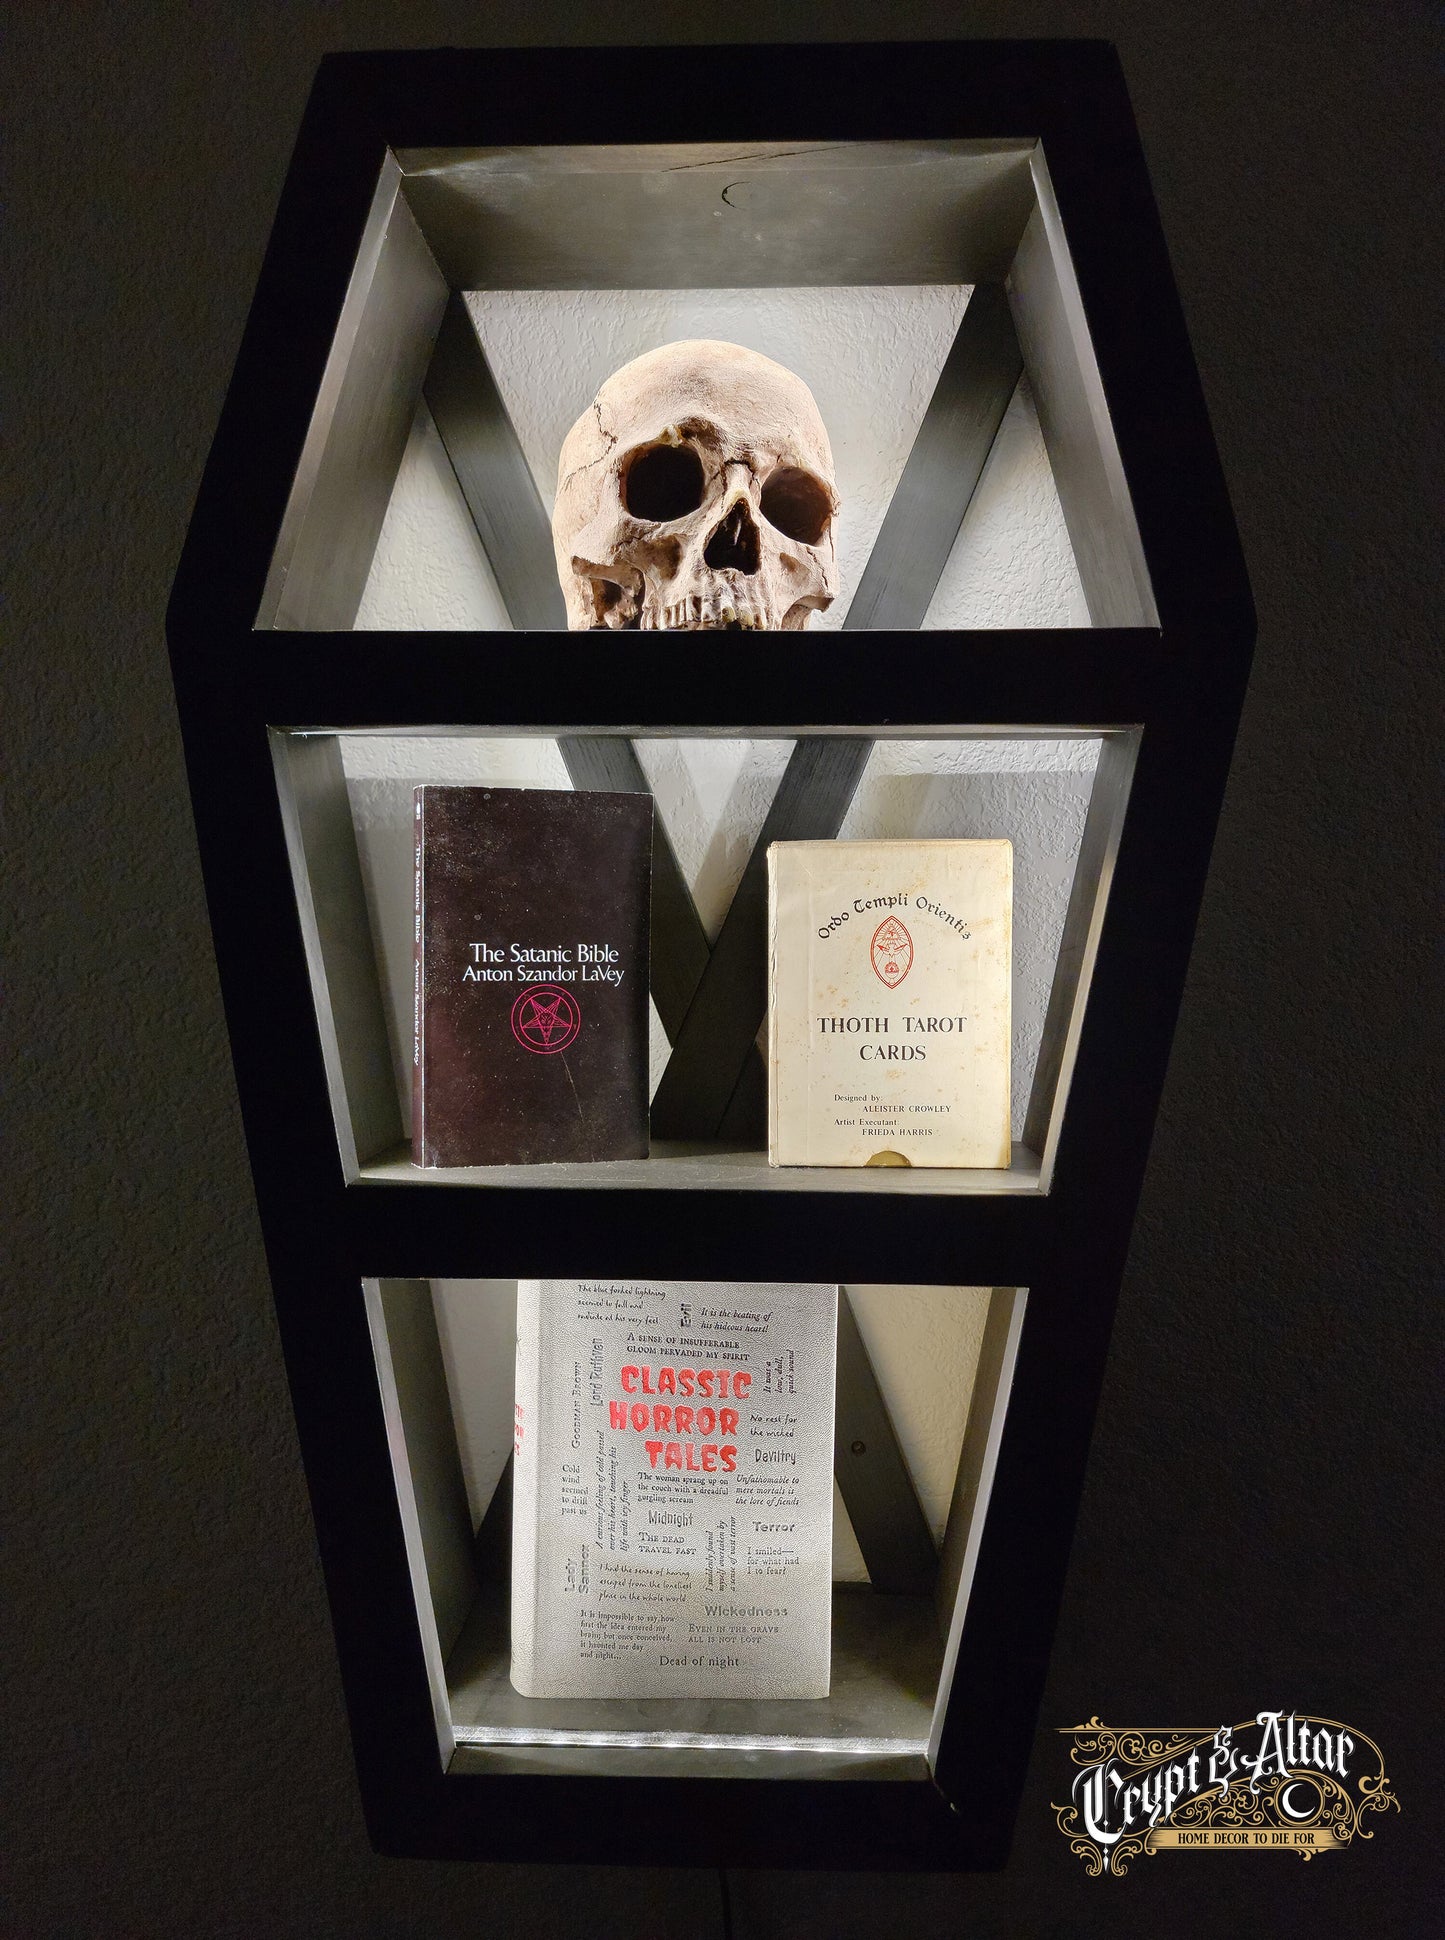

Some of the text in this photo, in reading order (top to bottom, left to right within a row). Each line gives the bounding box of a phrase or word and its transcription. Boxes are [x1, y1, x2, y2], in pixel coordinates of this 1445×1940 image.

[818, 893, 972, 940] Ordo Templi Orientis
[469, 943, 619, 962] The Satanic Bible
[462, 965, 625, 987] Anton Szandor LaVey
[817, 1017, 967, 1033] THOTH TAROT
[860, 1045, 926, 1061] CARDS
[834, 1094, 867, 1103] Designed
[834, 1118, 855, 1126] Artist
[578, 1284, 666, 1300] The blue forked lightning
[681, 1303, 692, 1327] Evil
[700, 1307, 773, 1322] It is the beating of
[700, 1321, 769, 1332] his hideous heart!
[627, 1332, 634, 1340] A
[639, 1335, 662, 1343] SENSE
[680, 1338, 740, 1349] INSUFFERABLE
[627, 1345, 656, 1354] GLOOM
[660, 1348, 702, 1358] PERVADED
[722, 1352, 750, 1360] SPIRIT
[775, 1356, 783, 1393] low, dull,
[786, 1349, 796, 1394] quick sound
[621, 1365, 752, 1399] CLASSIC
[590, 1383, 603, 1406] Lord
[763, 1386, 771, 1394] It
[609, 1401, 740, 1436] HORROR
[785, 1414, 797, 1425] for
[750, 1427, 794, 1437] the wicked
[597, 1430, 606, 1456] passed
[609, 1446, 617, 1458] his
[645, 1440, 738, 1472] TALES
[596, 1456, 604, 1472] cold
[596, 1472, 605, 1482] of
[609, 1460, 618, 1492] touching
[638, 1472, 652, 1480] The
[683, 1477, 705, 1485] sprang
[709, 1478, 716, 1486] up
[737, 1475, 790, 1484] Unfathomable
[596, 1484, 605, 1512] feeling
[700, 1487, 728, 1495] dreadful
[638, 1494, 666, 1503] gurgling
[750, 1497, 764, 1505] lore
[767, 1497, 777, 1506] of
[775, 1497, 800, 1507] fiends
[621, 1507, 631, 1517] icy
[648, 1510, 693, 1527] Midnight
[596, 1513, 604, 1540] curious
[608, 1521, 616, 1532] his
[752, 1521, 795, 1532] Terror
[639, 1532, 684, 1543] THE DEAD
[620, 1538, 629, 1552] life
[639, 1546, 672, 1554] TRAVEL
[747, 1557, 799, 1565] for what had
[605, 1563, 619, 1572] had
[621, 1565, 632, 1573] the
[656, 1568, 664, 1576] of
[666, 1568, 690, 1580] having
[747, 1566, 751, 1574] I
[600, 1579, 692, 1589] escaped from the loneliest
[599, 1590, 617, 1601] place
[666, 1594, 687, 1602] world
[705, 1605, 788, 1616] Wickedness
[688, 1624, 712, 1633] EVEN
[660, 1655, 739, 1669] Dead of night
